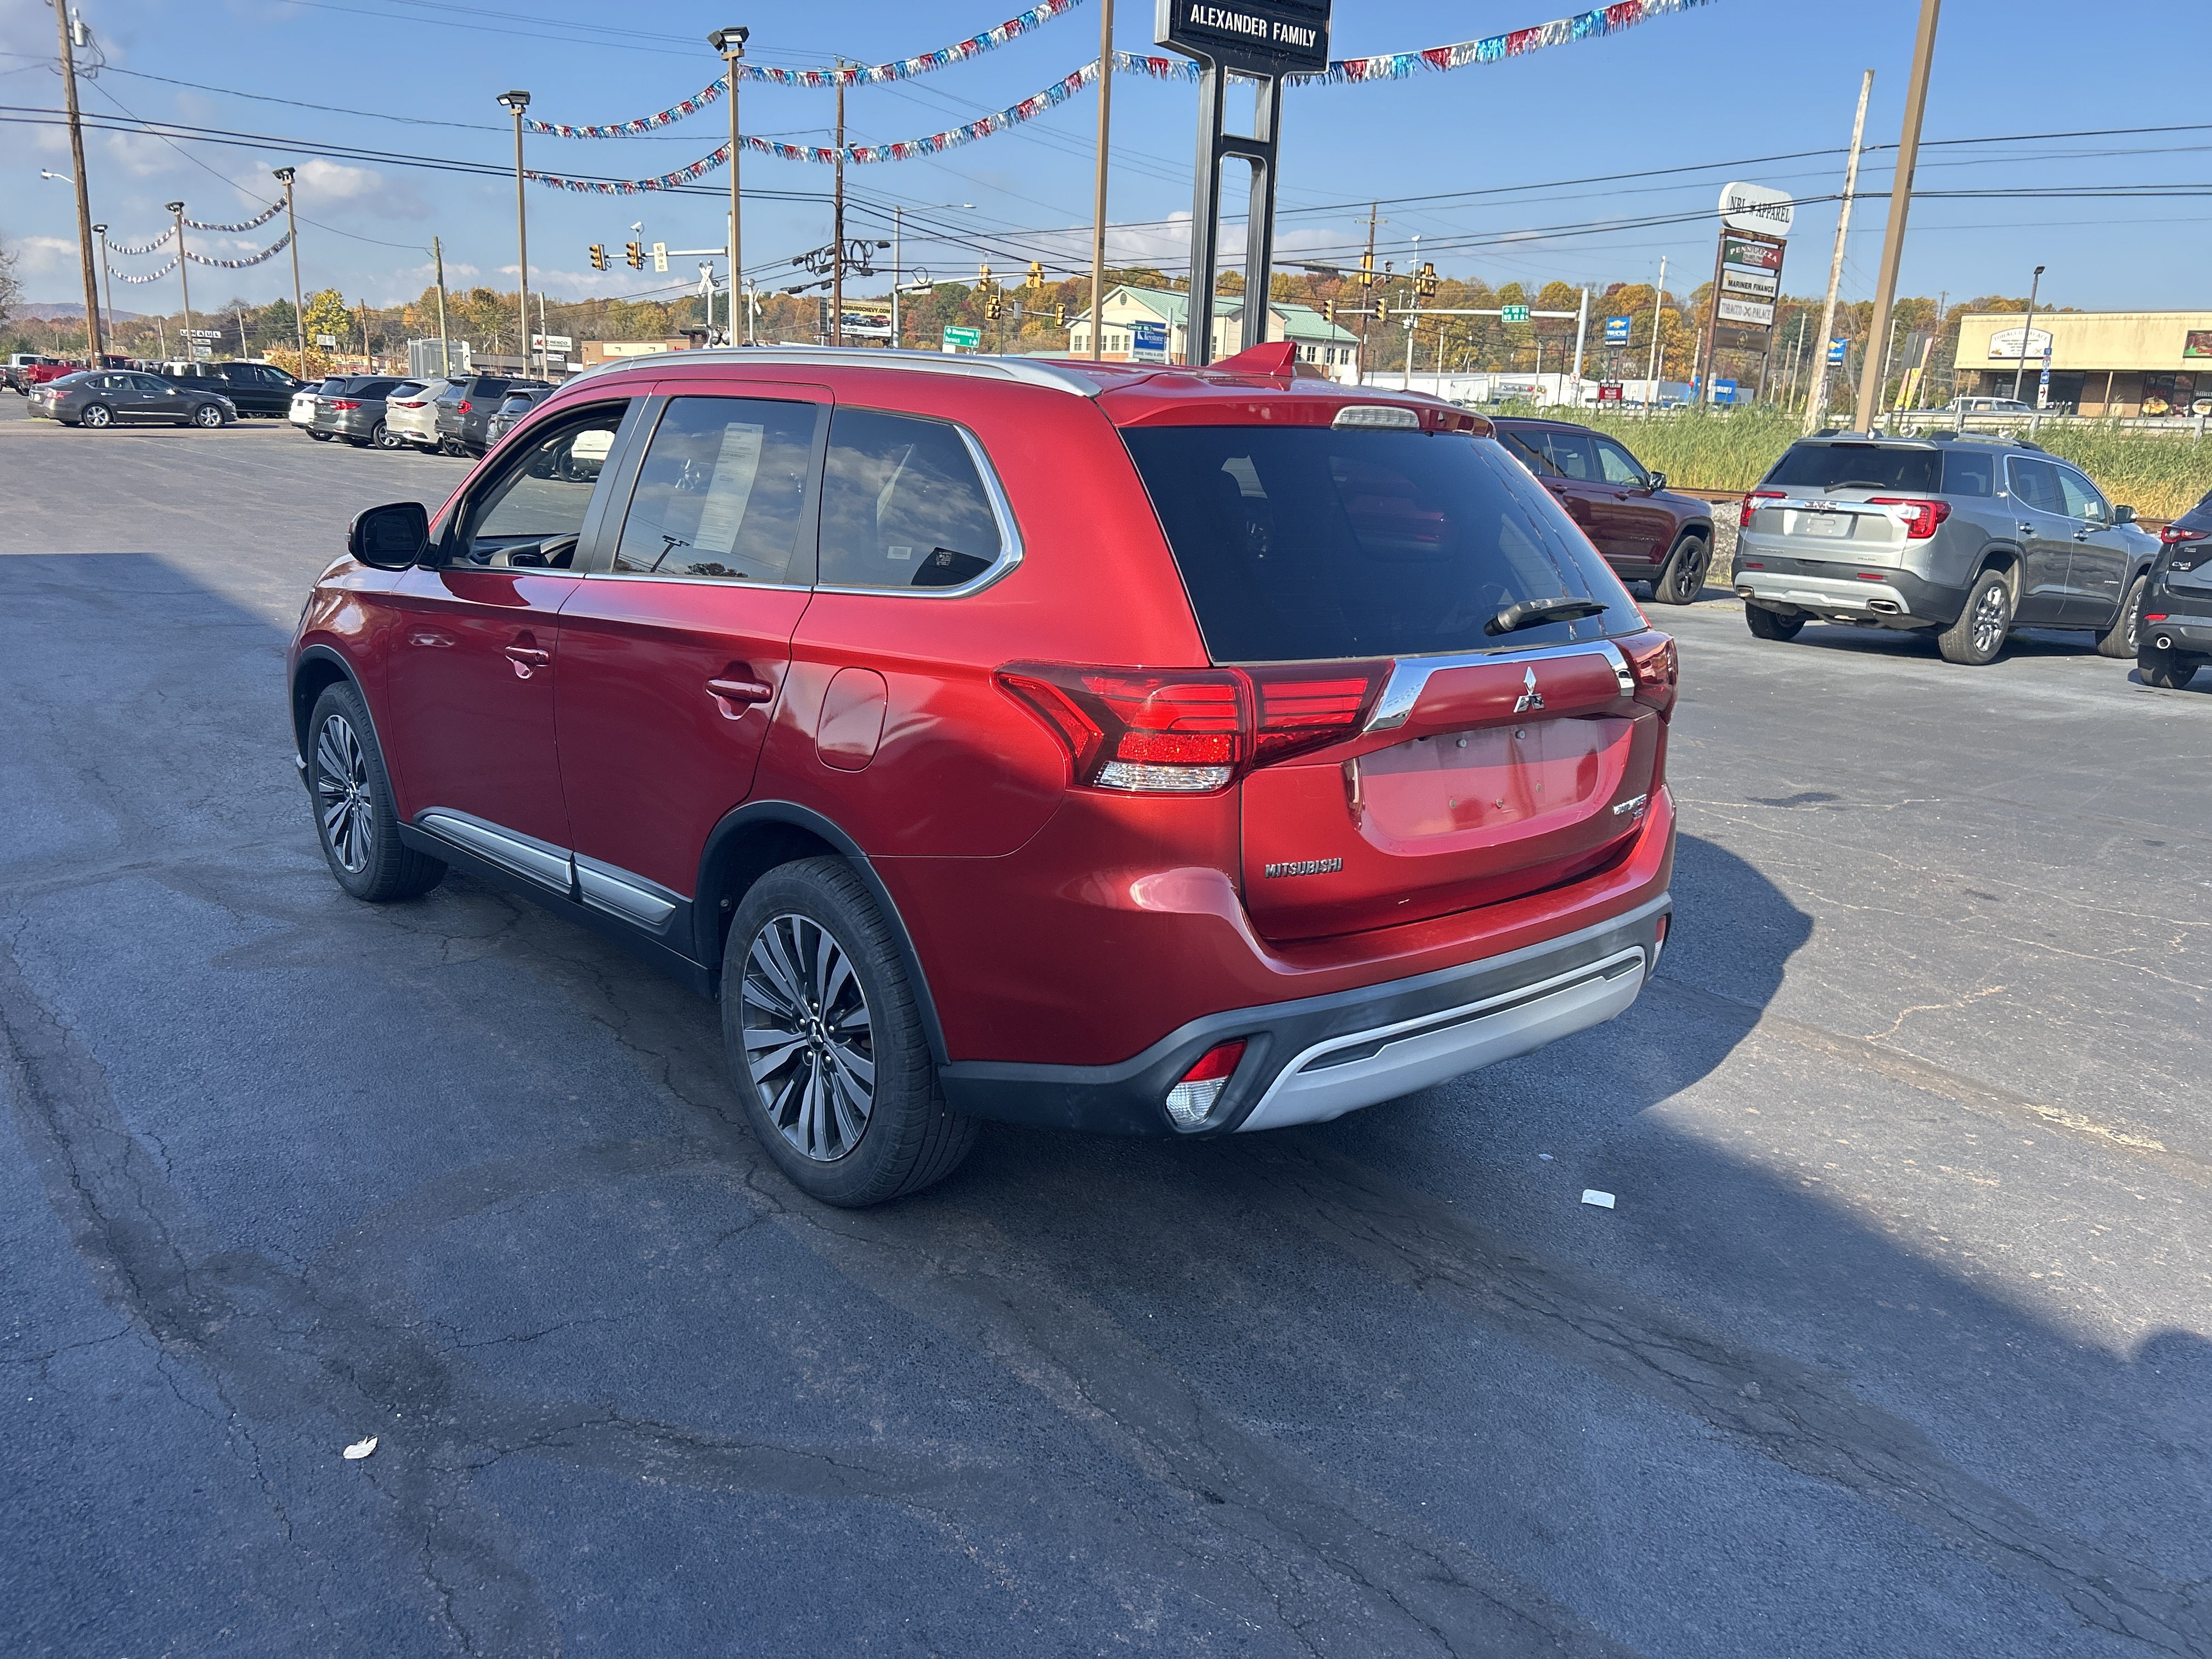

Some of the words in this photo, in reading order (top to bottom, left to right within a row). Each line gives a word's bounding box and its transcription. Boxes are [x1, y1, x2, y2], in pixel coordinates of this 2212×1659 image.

[1190, 4, 1267, 38] ALEXANDER
[1273, 22, 1316, 48] FAMILY
[1756, 201, 1790, 223] APPAREL
[1730, 245, 1752, 255] PENN
[1754, 247, 1777, 263] PIZZA
[1728, 280, 1752, 291] MARINER
[1753, 283, 1774, 294] FINANCE
[829, 304, 890, 314] BLMSBURGCHEVY.COM
[1722, 302, 1743, 314] TOBACCO
[1752, 305, 1771, 320] PALACE
[2029, 331, 2048, 341] ALACE
[1265, 857, 1344, 878] MITSUBISHI
